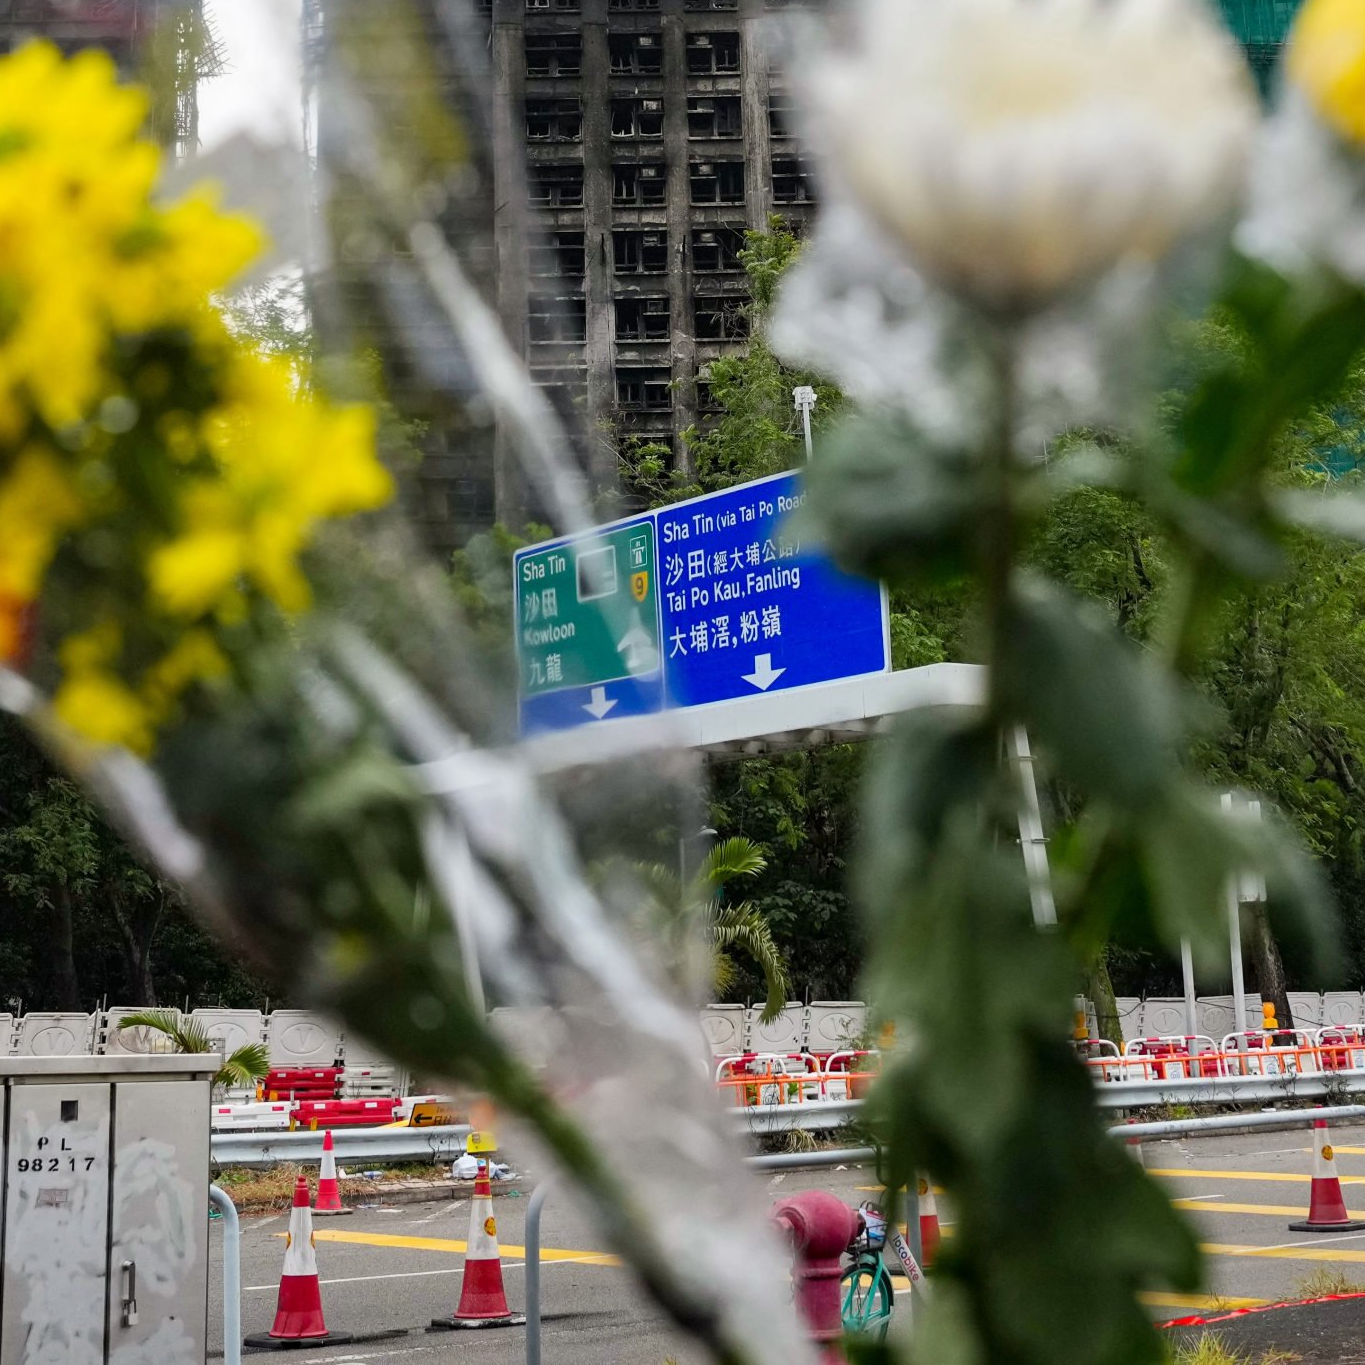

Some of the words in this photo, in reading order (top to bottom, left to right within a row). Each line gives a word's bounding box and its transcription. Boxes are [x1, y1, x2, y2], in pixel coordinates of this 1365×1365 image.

[663, 521, 689, 543] Sha
[692, 513, 713, 535] Tin
[716, 510, 736, 532] (via
[739, 503, 755, 523] Tai
[759, 501, 773, 518] Po
[523, 561, 545, 582] Sha
[547, 555, 566, 575] Tin
[635, 577, 644, 595] 9
[666, 590, 686, 613] Tai
[691, 586, 709, 608] Po
[524, 587, 558, 624] 沙田
[523, 621, 575, 645] Kowloon
[529, 653, 563, 685] 九龍
[17, 1157, 95, 1172] 98217
[892, 1235, 920, 1281] locobike
